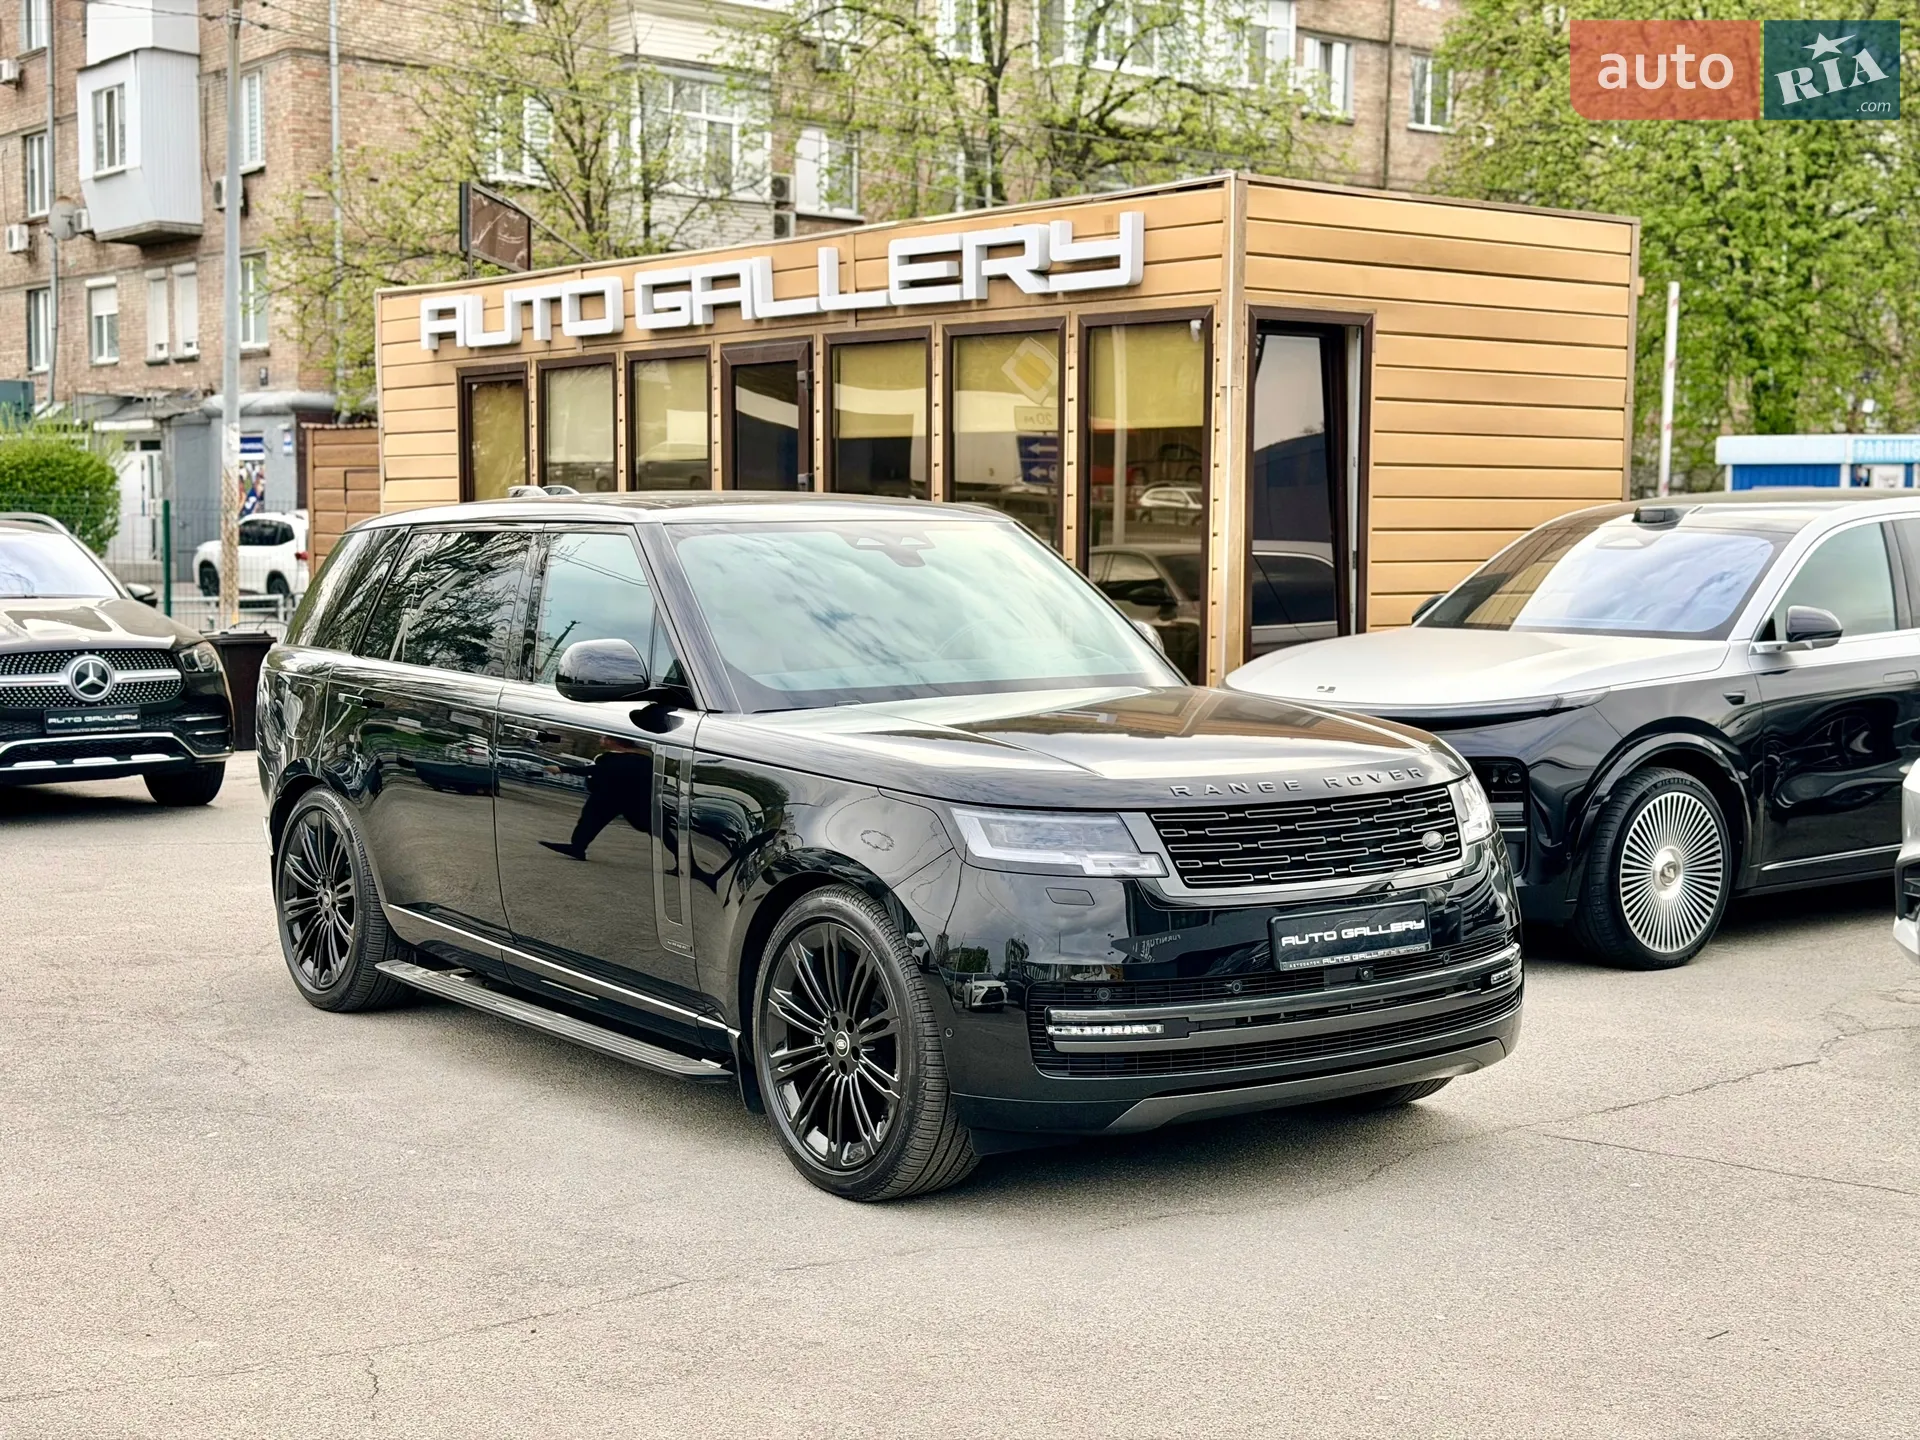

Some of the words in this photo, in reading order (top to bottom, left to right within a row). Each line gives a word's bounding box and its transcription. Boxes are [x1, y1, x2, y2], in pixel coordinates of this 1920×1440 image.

[420, 275, 625, 350] AUTO
[634, 211, 1145, 330] GALLERY
[47, 716, 82, 724] AUTO
[84, 714, 138, 722] GALLERY
[1169, 779, 1303, 797] RANGE
[1322, 767, 1424, 788] ROVER
[1281, 930, 1337, 947] AUTO
[1341, 919, 1425, 939] GALLERY
[1322, 956, 1350, 965] AUTO
